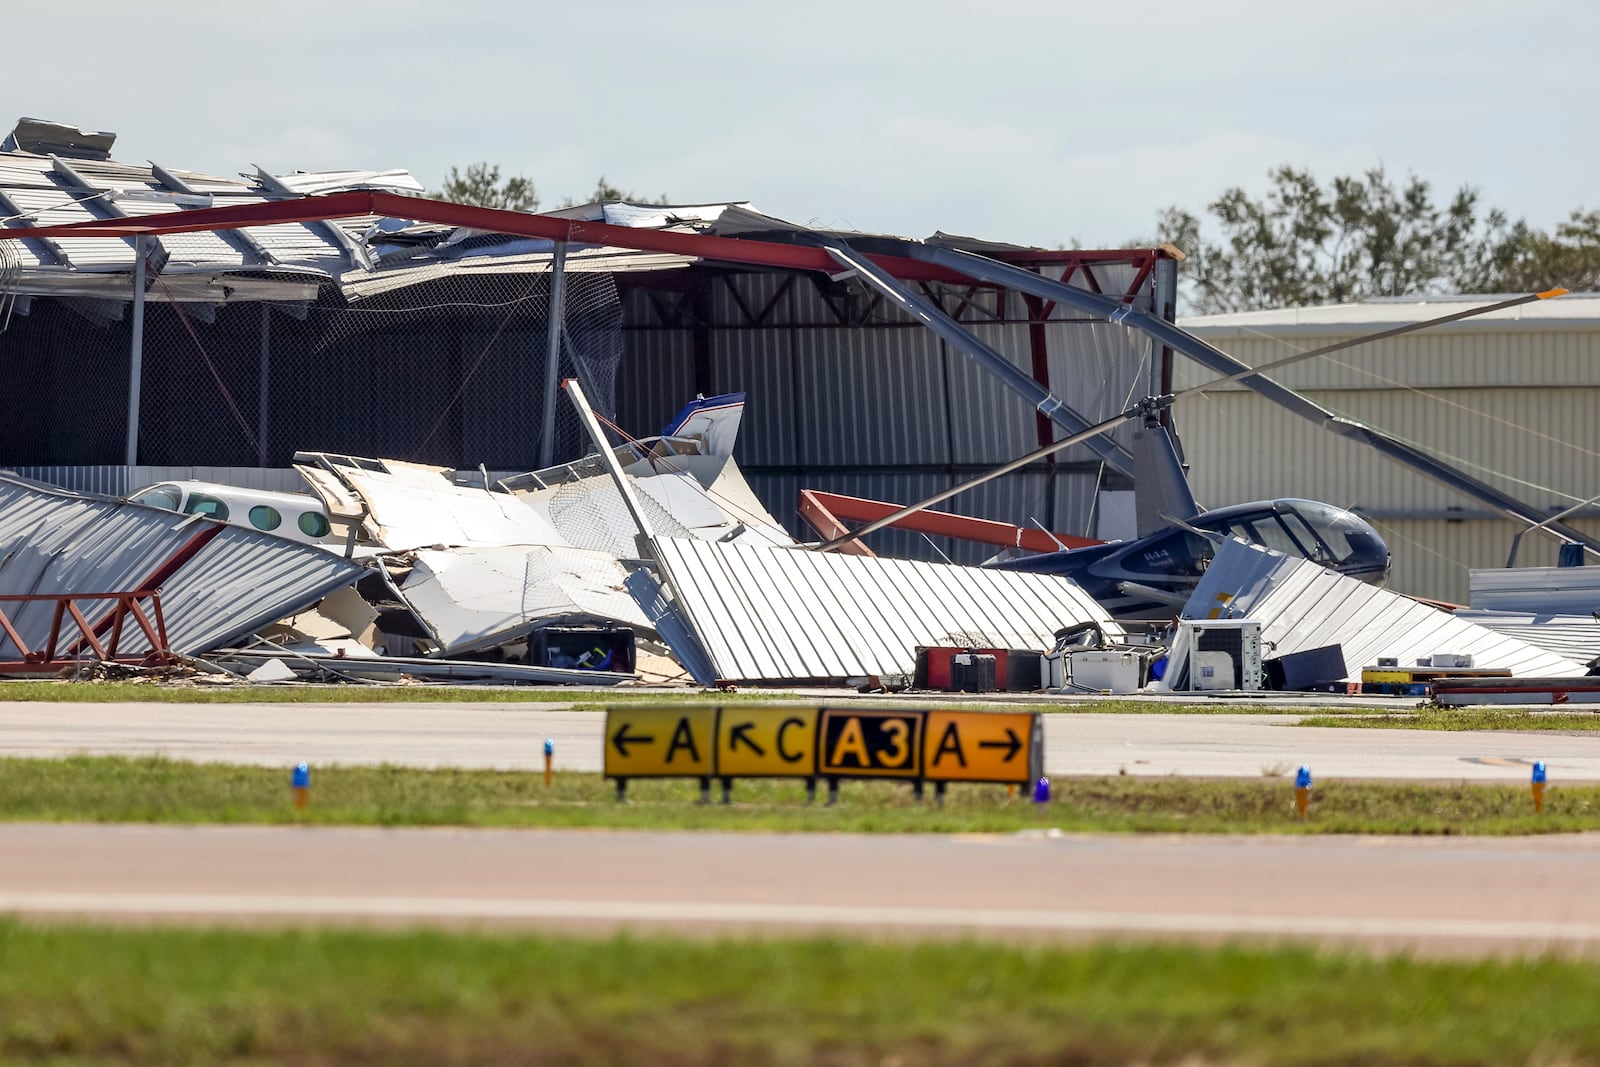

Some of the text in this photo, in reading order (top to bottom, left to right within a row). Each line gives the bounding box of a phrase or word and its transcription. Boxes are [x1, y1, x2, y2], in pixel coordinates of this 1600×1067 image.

[665, 716, 967, 768] A C A3 A
